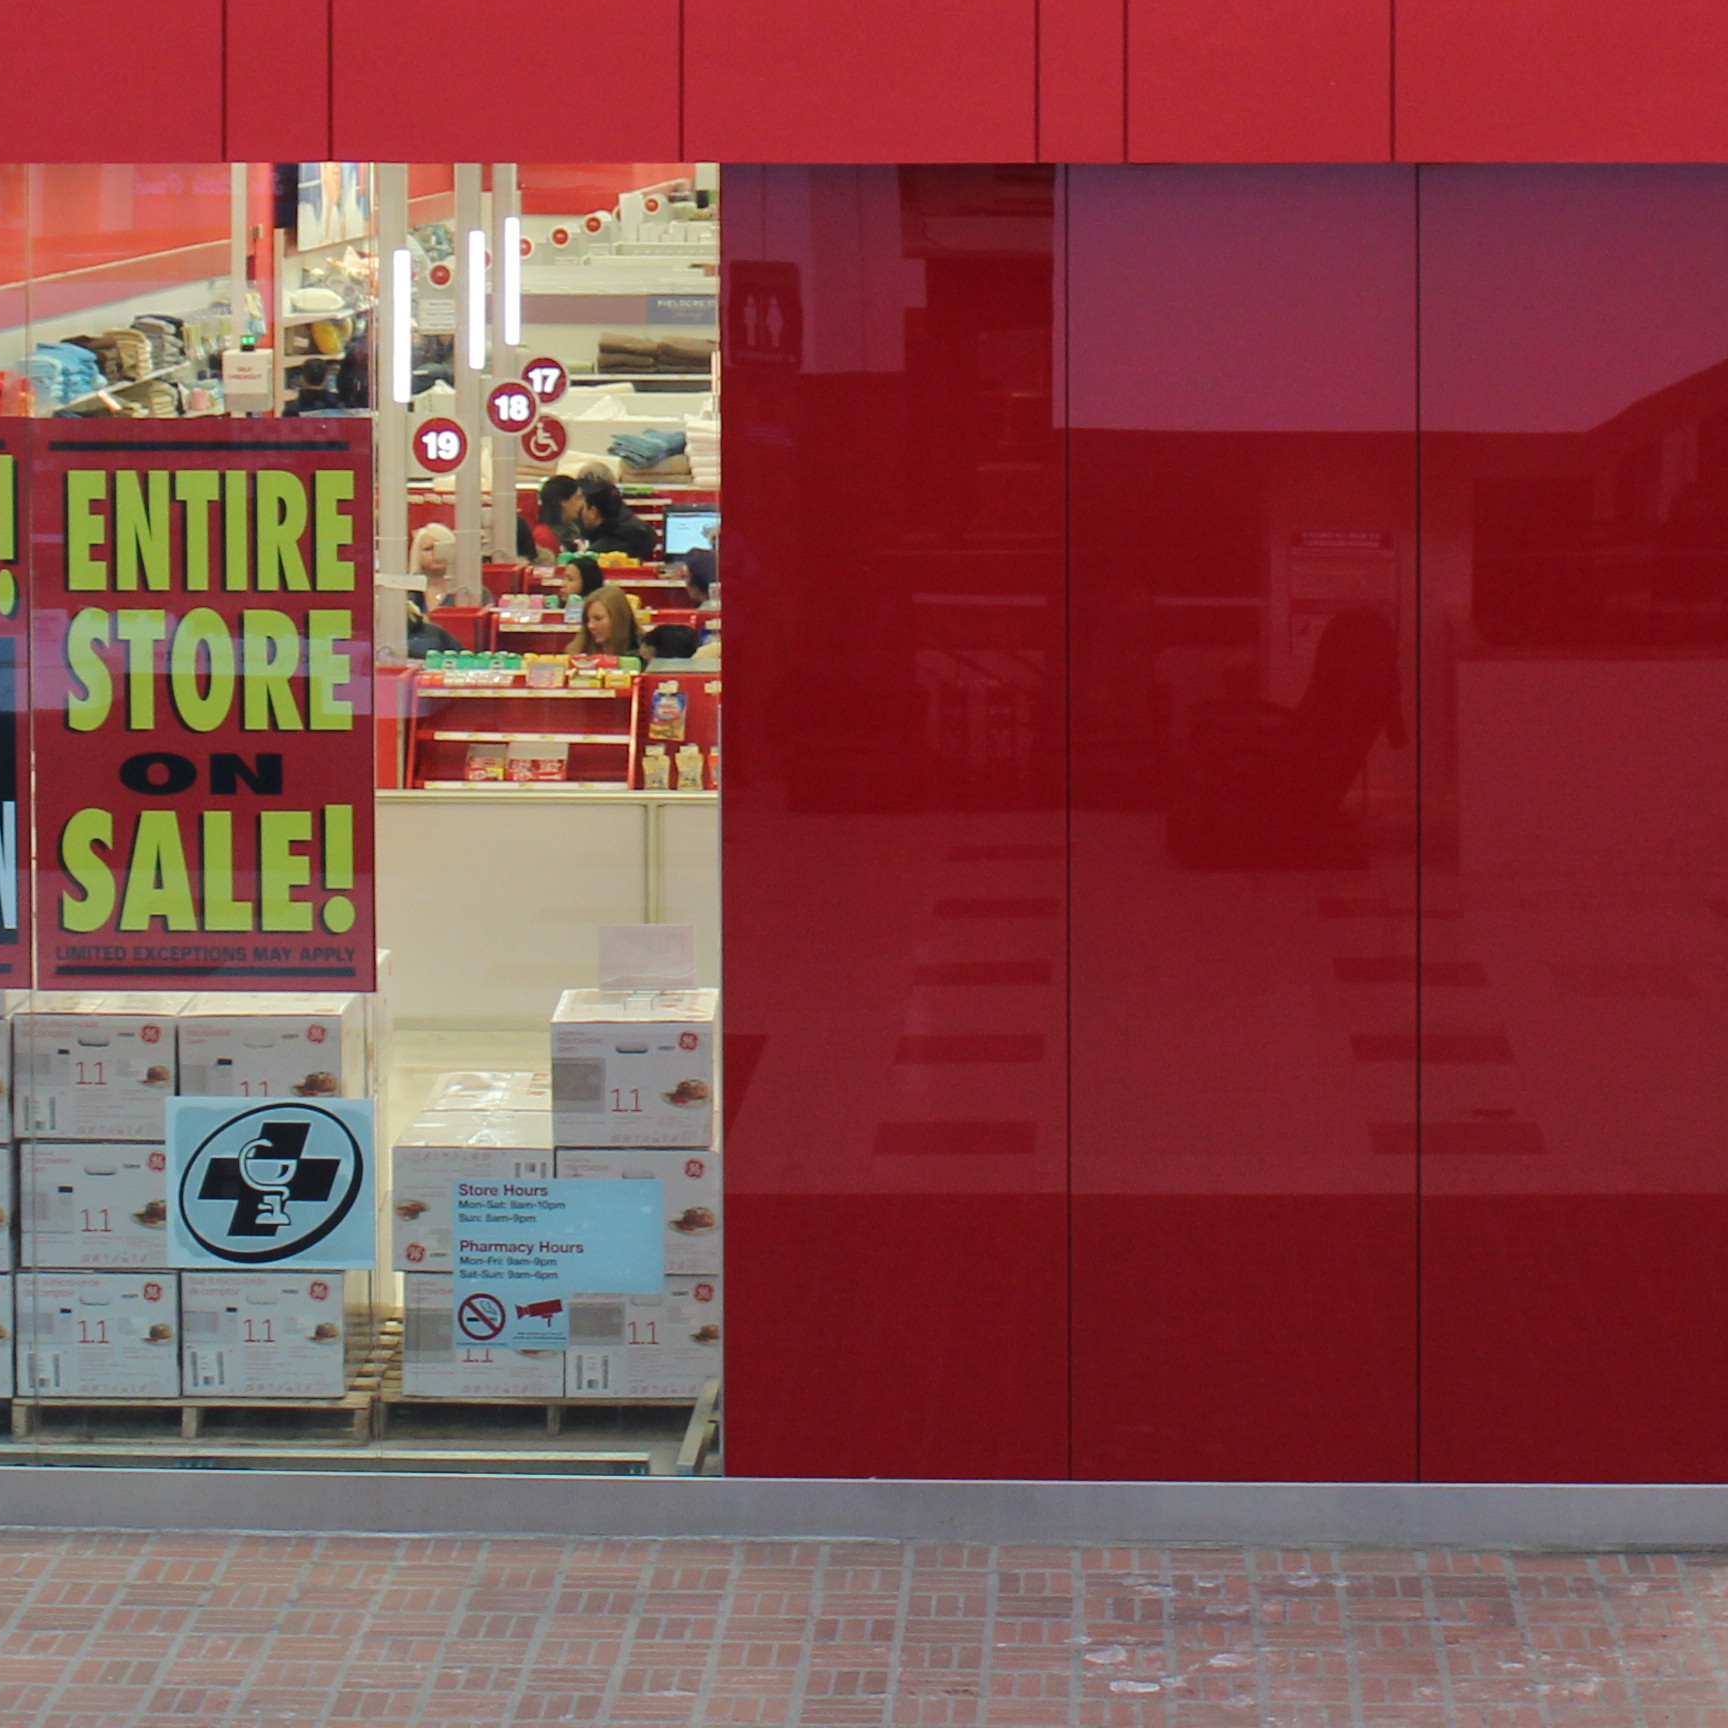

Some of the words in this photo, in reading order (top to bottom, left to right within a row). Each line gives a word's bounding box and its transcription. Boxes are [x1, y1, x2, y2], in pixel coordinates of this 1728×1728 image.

[529, 367, 561, 393] 17
[493, 394, 530, 421] 18
[421, 432, 460, 460] 19
[66, 470, 355, 594] ENTIRE
[66, 607, 353, 733] STORE
[119, 752, 282, 795] ON
[59, 803, 355, 936] SALE!
[56, 946, 126, 961] LIMITED
[133, 946, 247, 962] EXCEPTIONS
[253, 947, 292, 962] MAY
[300, 947, 356, 962] APPLY
[458, 1183, 499, 1197] Store
[503, 1184, 549, 1197] Hours
[458, 1200, 507, 1210] Mon-Sat:
[510, 1200, 566, 1212] 8am-10pm
[458, 1213, 482, 1223] Sun:
[459, 1240, 534, 1255] Pharmacy
[539, 1241, 584, 1253] Hours
[459, 1256, 502, 1266] Mon-Fri:
[506, 1257, 557, 1268] 9am-9pm
[459, 1269, 505, 1279] Sat-Sun:
